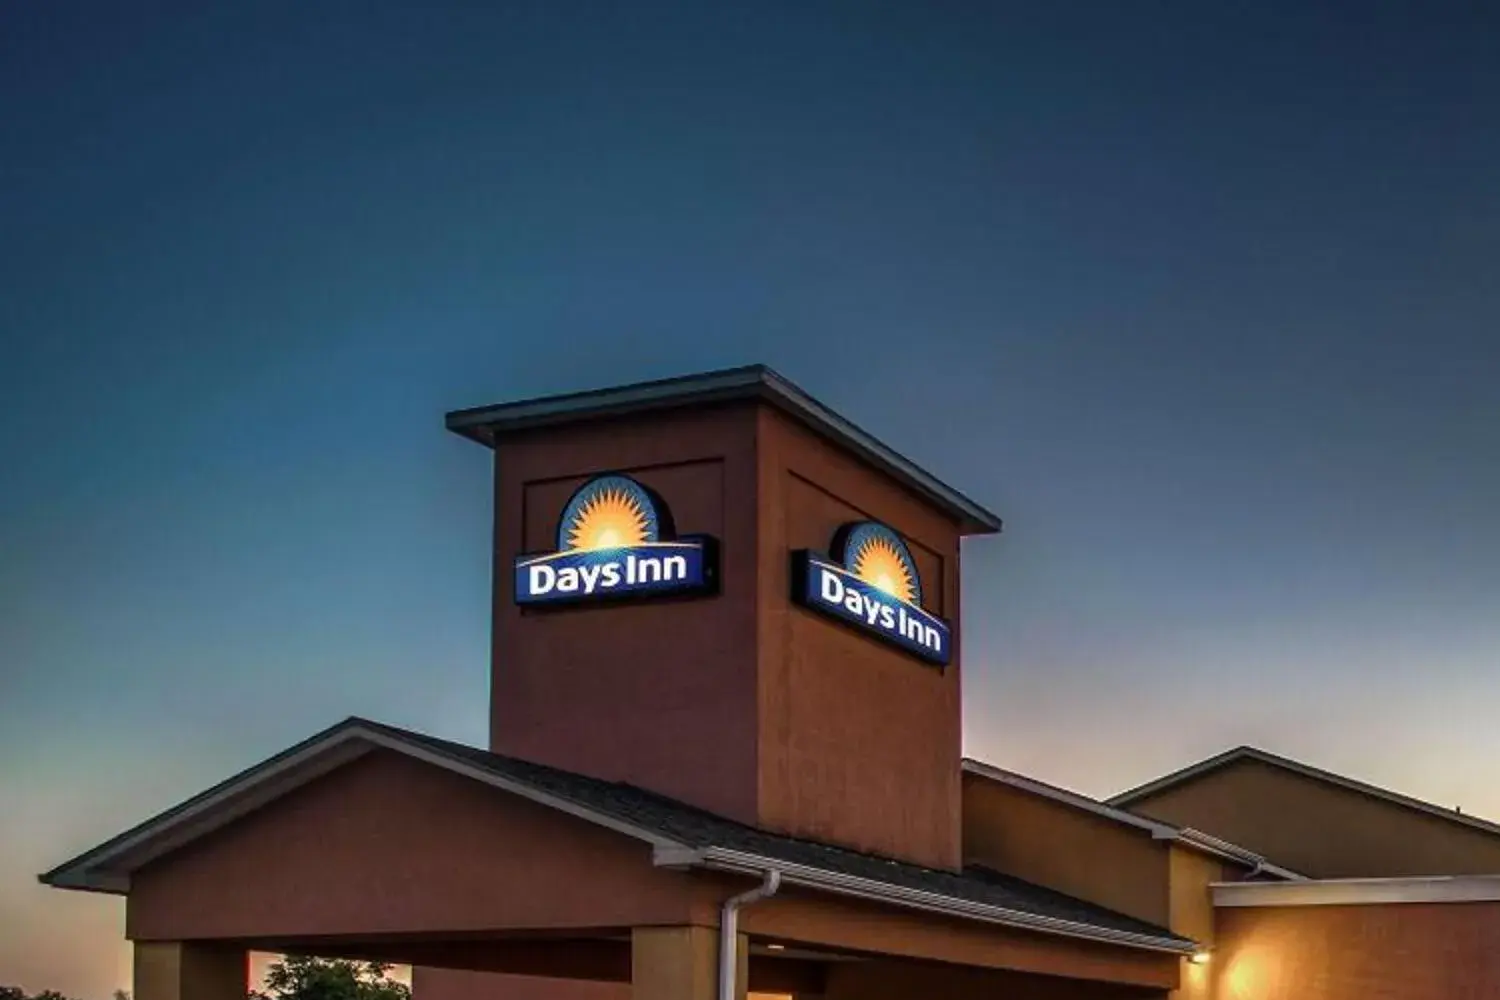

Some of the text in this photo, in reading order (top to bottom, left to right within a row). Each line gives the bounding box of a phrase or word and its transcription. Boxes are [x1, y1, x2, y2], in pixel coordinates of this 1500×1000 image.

[529, 555, 686, 594] Days Inn
[821, 569, 941, 651] Days Inn
